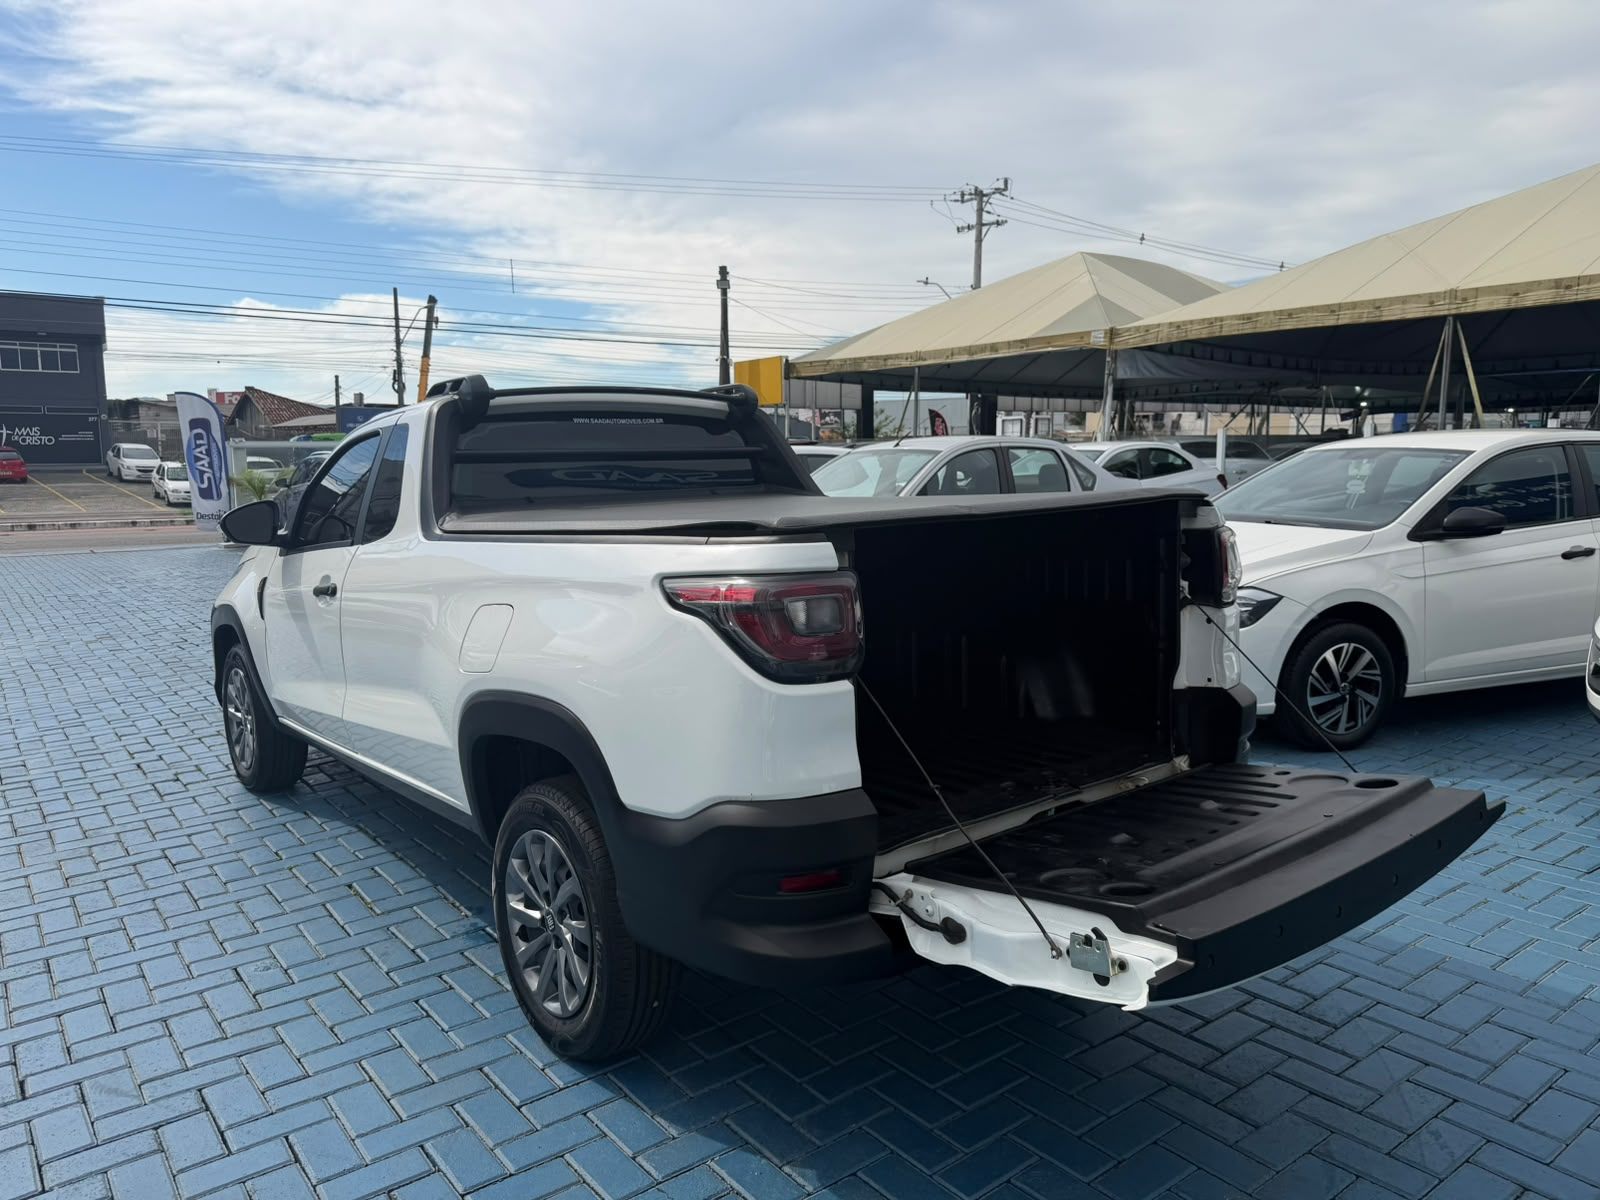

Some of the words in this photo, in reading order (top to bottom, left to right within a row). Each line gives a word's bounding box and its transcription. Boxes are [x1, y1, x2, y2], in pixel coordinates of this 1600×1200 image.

[14, 426, 40, 435] MAIS
[19, 436, 55, 445] CRISTO
[191, 428, 217, 499] SAAD
